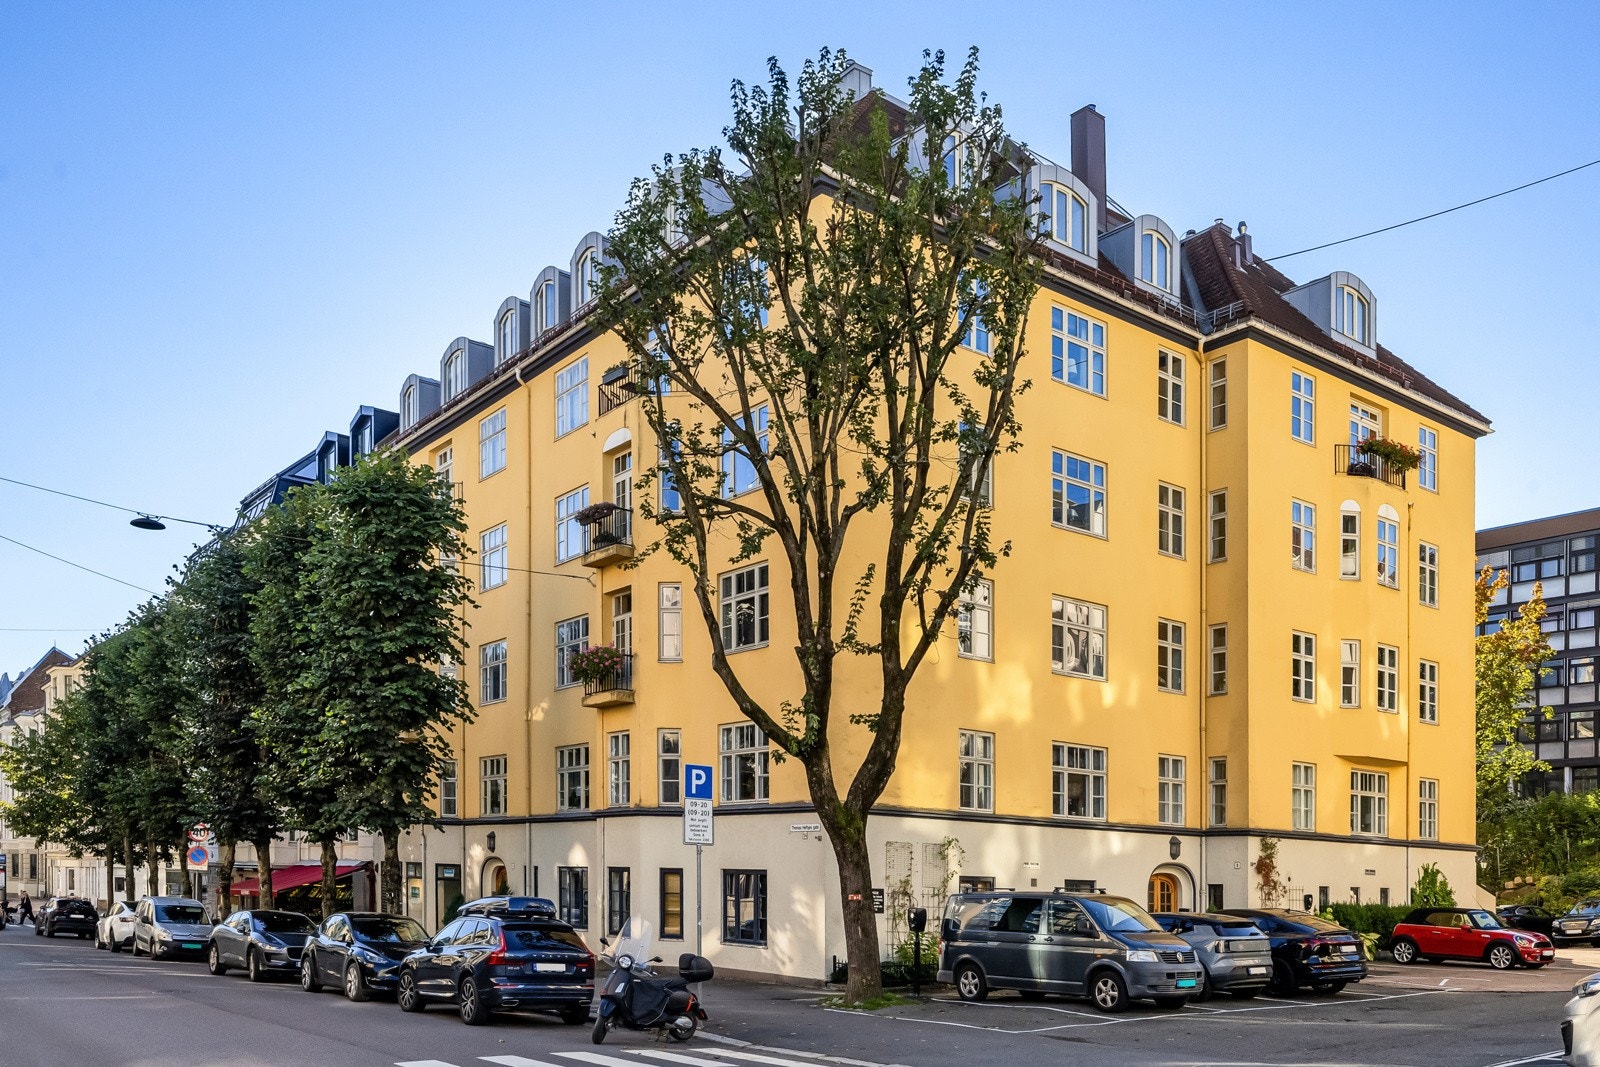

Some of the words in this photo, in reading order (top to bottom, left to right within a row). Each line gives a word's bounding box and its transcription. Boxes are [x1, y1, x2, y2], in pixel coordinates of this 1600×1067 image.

[691, 769, 706, 794] P
[688, 809, 710, 817] (09-20)
[193, 828, 205, 837] 40
